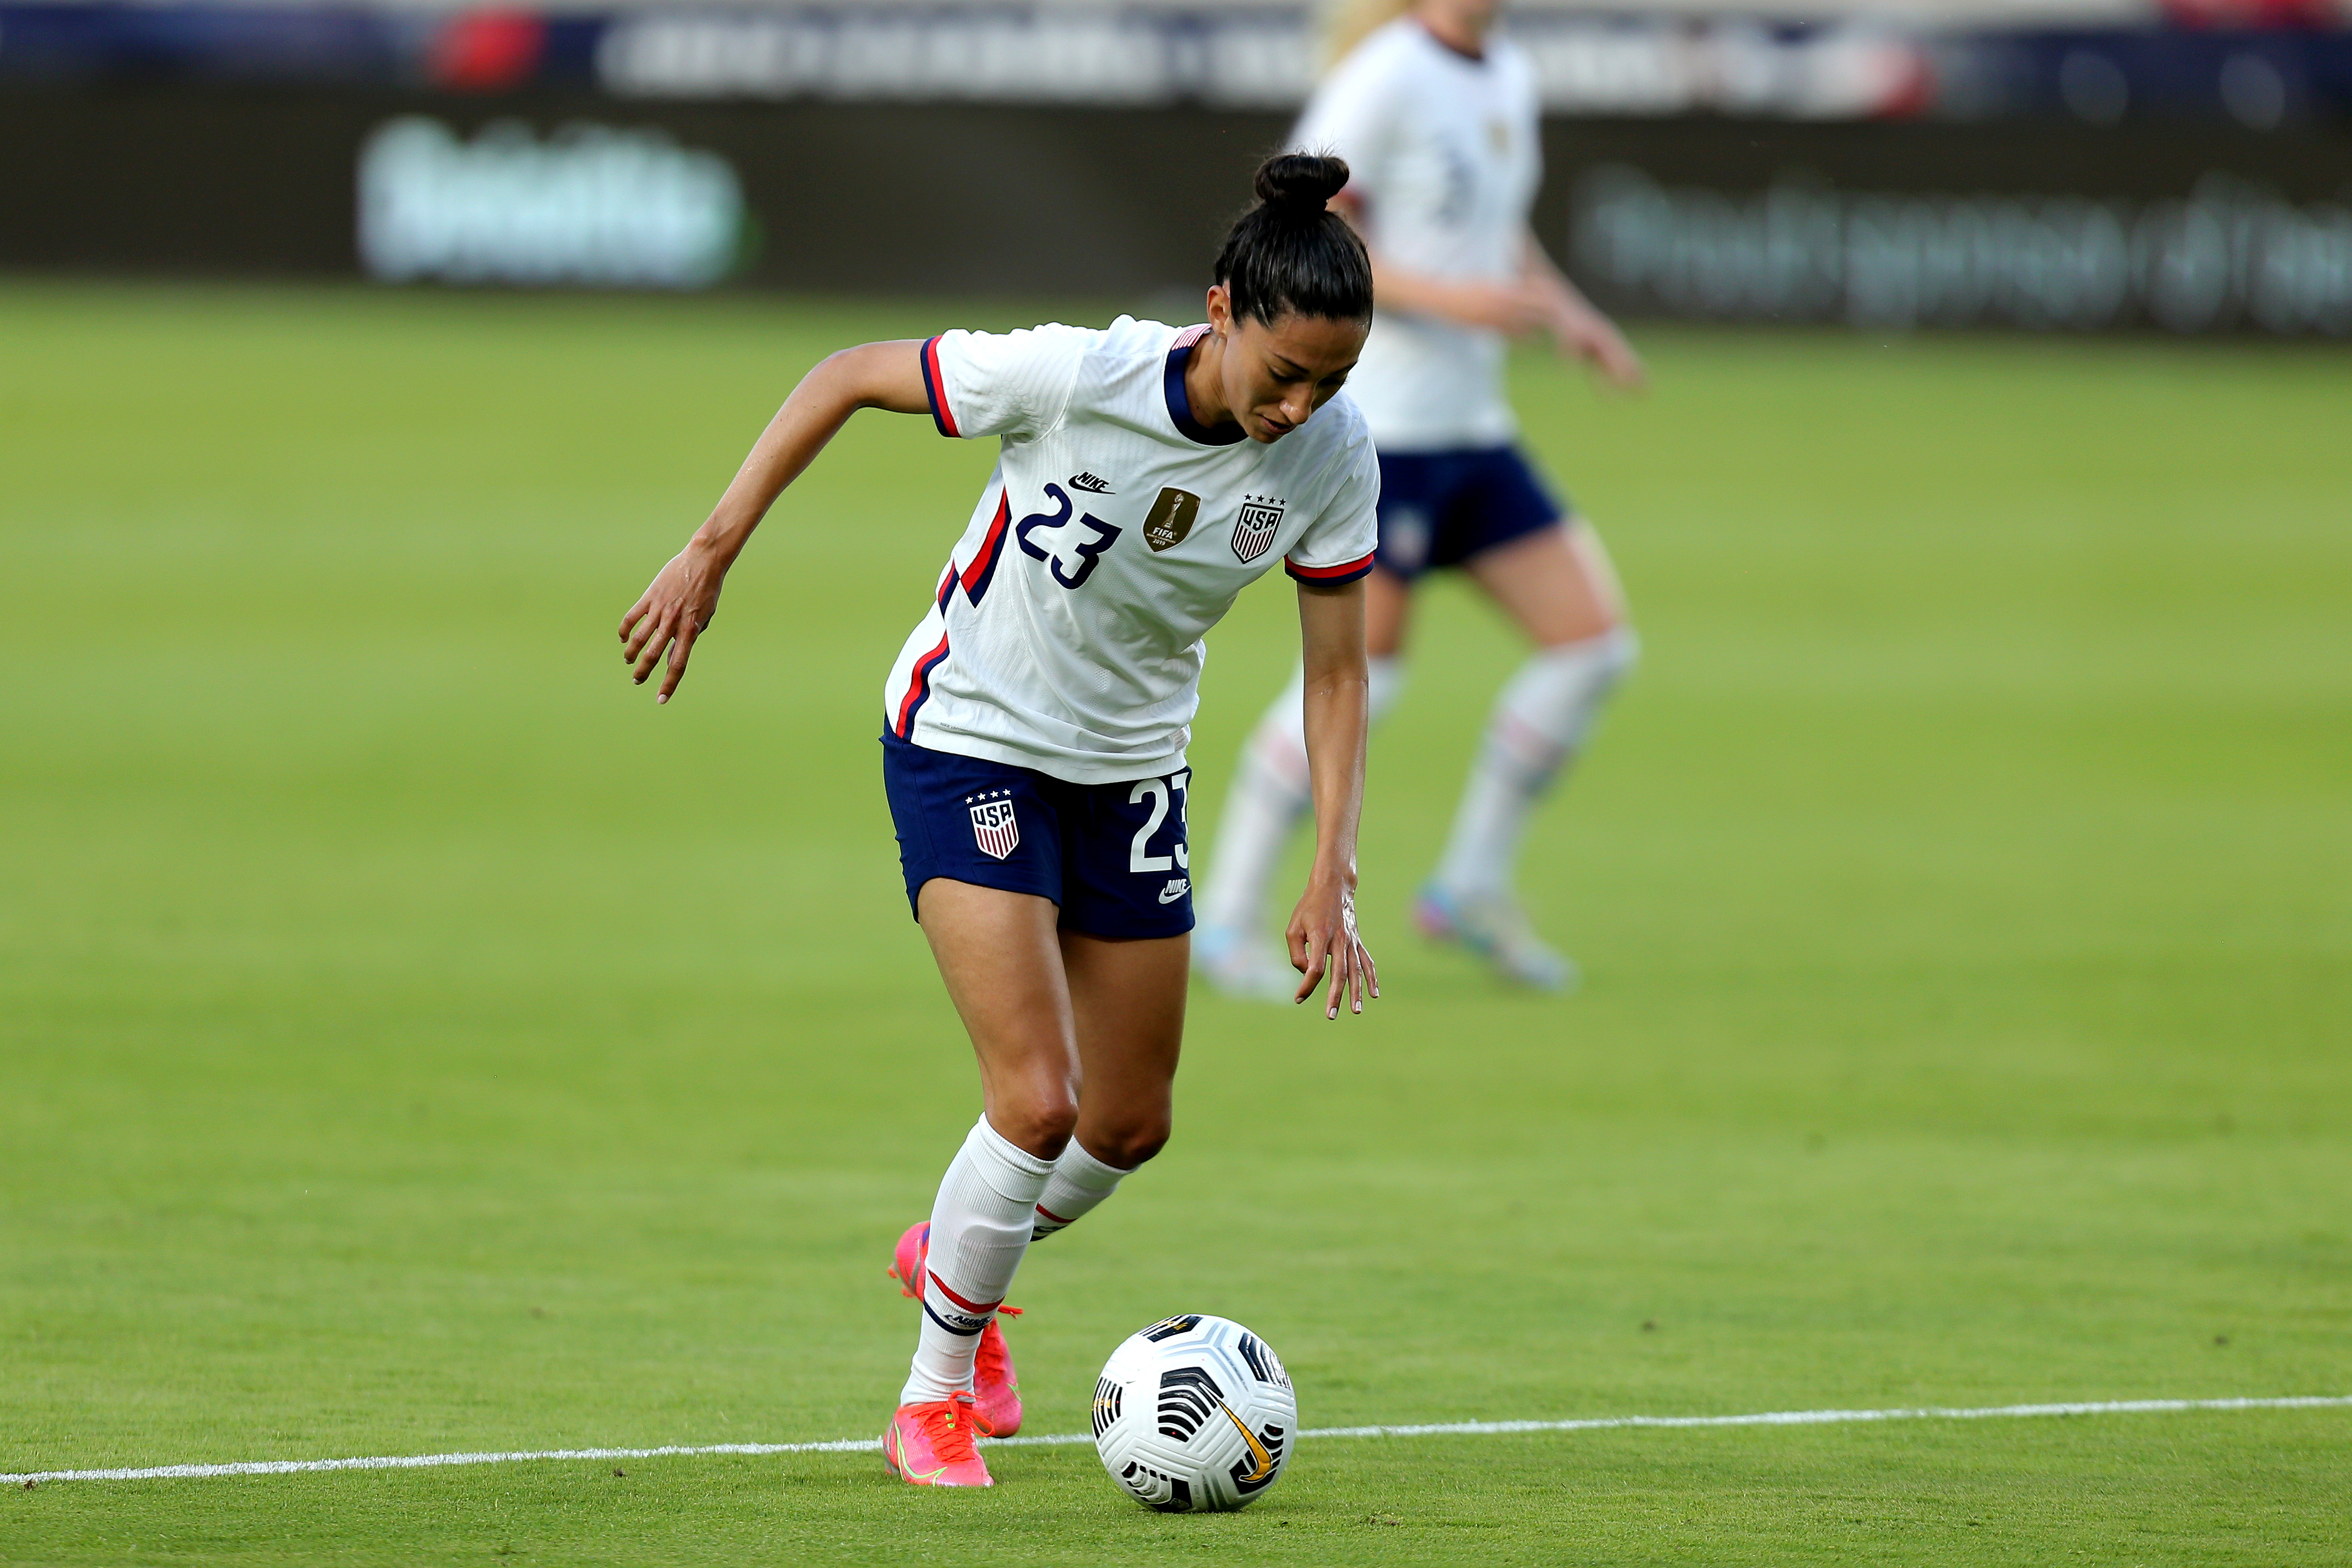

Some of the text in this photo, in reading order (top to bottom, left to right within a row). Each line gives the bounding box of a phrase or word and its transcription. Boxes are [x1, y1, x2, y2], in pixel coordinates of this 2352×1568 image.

[1076, 471, 1109, 489] NIKE
[1243, 509, 1278, 531] USA
[1016, 483, 1122, 589] 23
[1153, 527, 1173, 539] FIFA
[973, 803, 1012, 827] USA
[1165, 879, 1187, 893] NIKE
